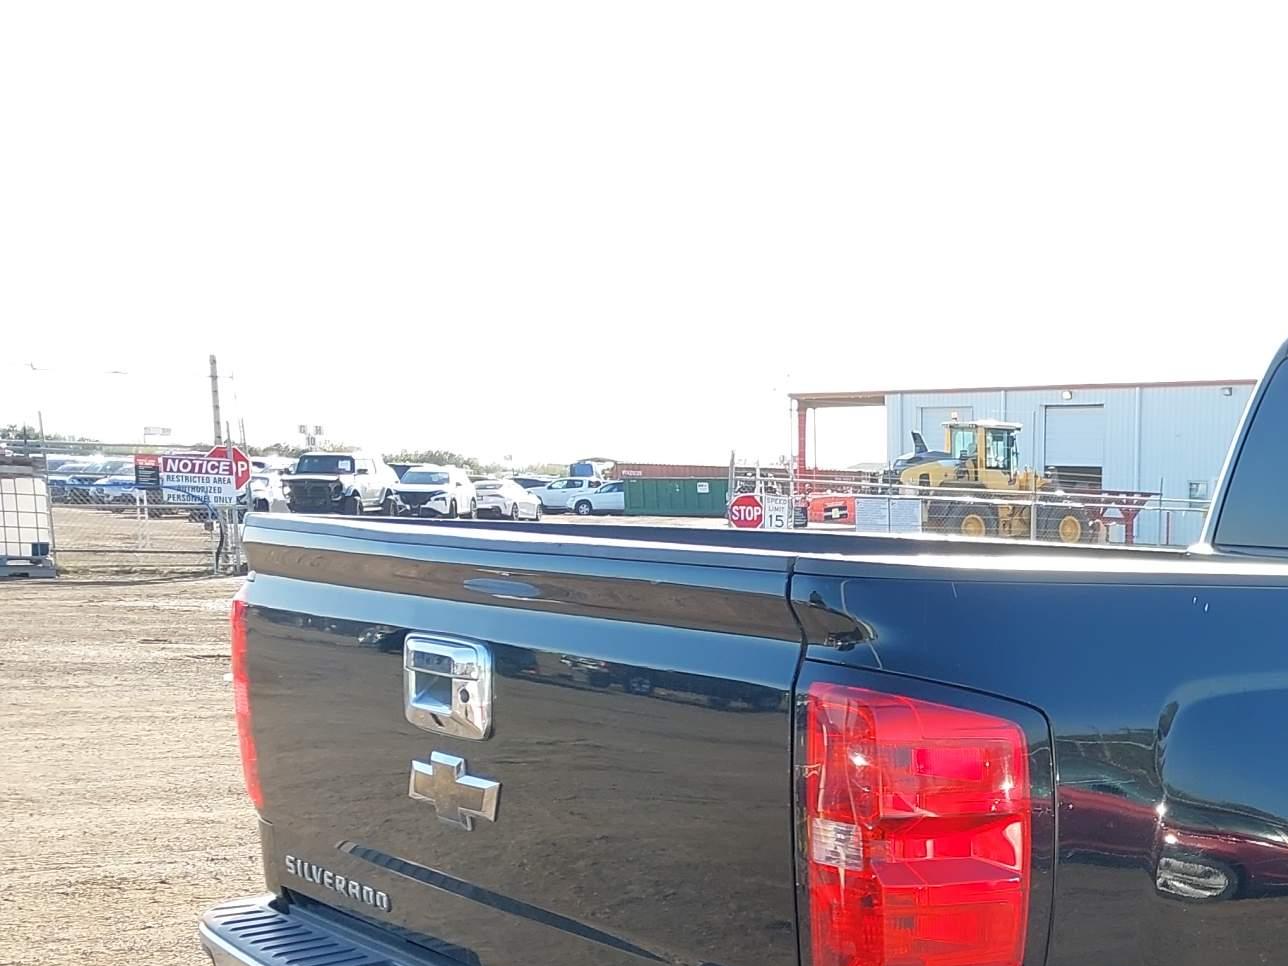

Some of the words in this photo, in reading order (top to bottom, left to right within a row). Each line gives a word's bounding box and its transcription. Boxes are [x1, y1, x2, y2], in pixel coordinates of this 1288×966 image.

[166, 459, 230, 475] NOTICE
[166, 474, 211, 484] RESTRICTED
[213, 476, 232, 485] AREA
[213, 495, 233, 504] ONLY
[766, 497, 787, 505] SPEED
[731, 505, 762, 521] STOP
[768, 514, 785, 528] 15
[284, 854, 392, 912] SILVERADO
